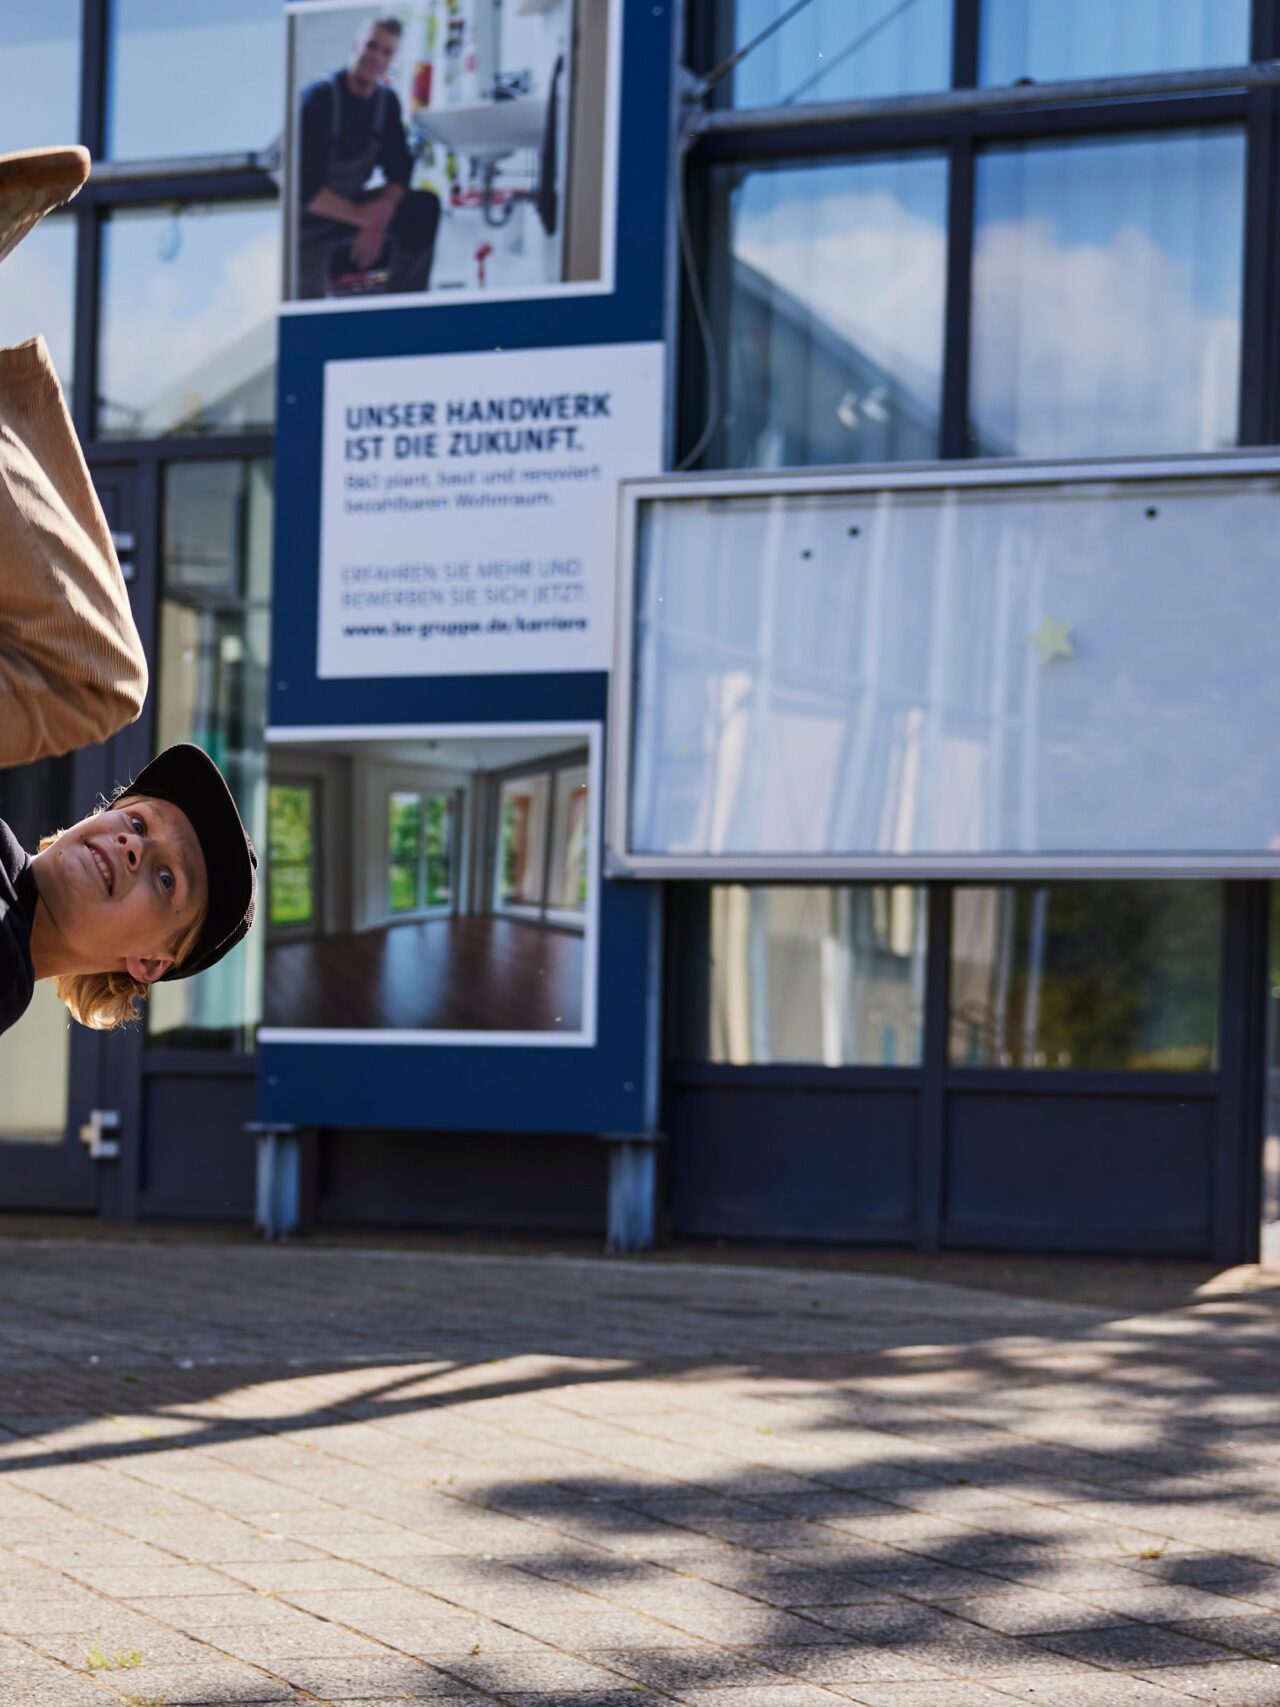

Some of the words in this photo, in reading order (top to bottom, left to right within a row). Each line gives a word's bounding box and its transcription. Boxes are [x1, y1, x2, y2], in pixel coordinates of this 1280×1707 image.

[345, 402, 437, 431] UNSER
[446, 393, 612, 425] HANDWERK
[345, 434, 384, 462] IST
[394, 432, 439, 459] DIE
[448, 425, 585, 457] ZUKUNFT.
[481, 468, 514, 486] und
[342, 563, 437, 585] ERFAHREN
[443, 561, 470, 580] SIE
[477, 559, 532, 579] MEHR
[538, 557, 582, 578] UND
[341, 588, 444, 609] BEWERBEN
[449, 587, 477, 606] SIE
[484, 584, 528, 606] SICH
